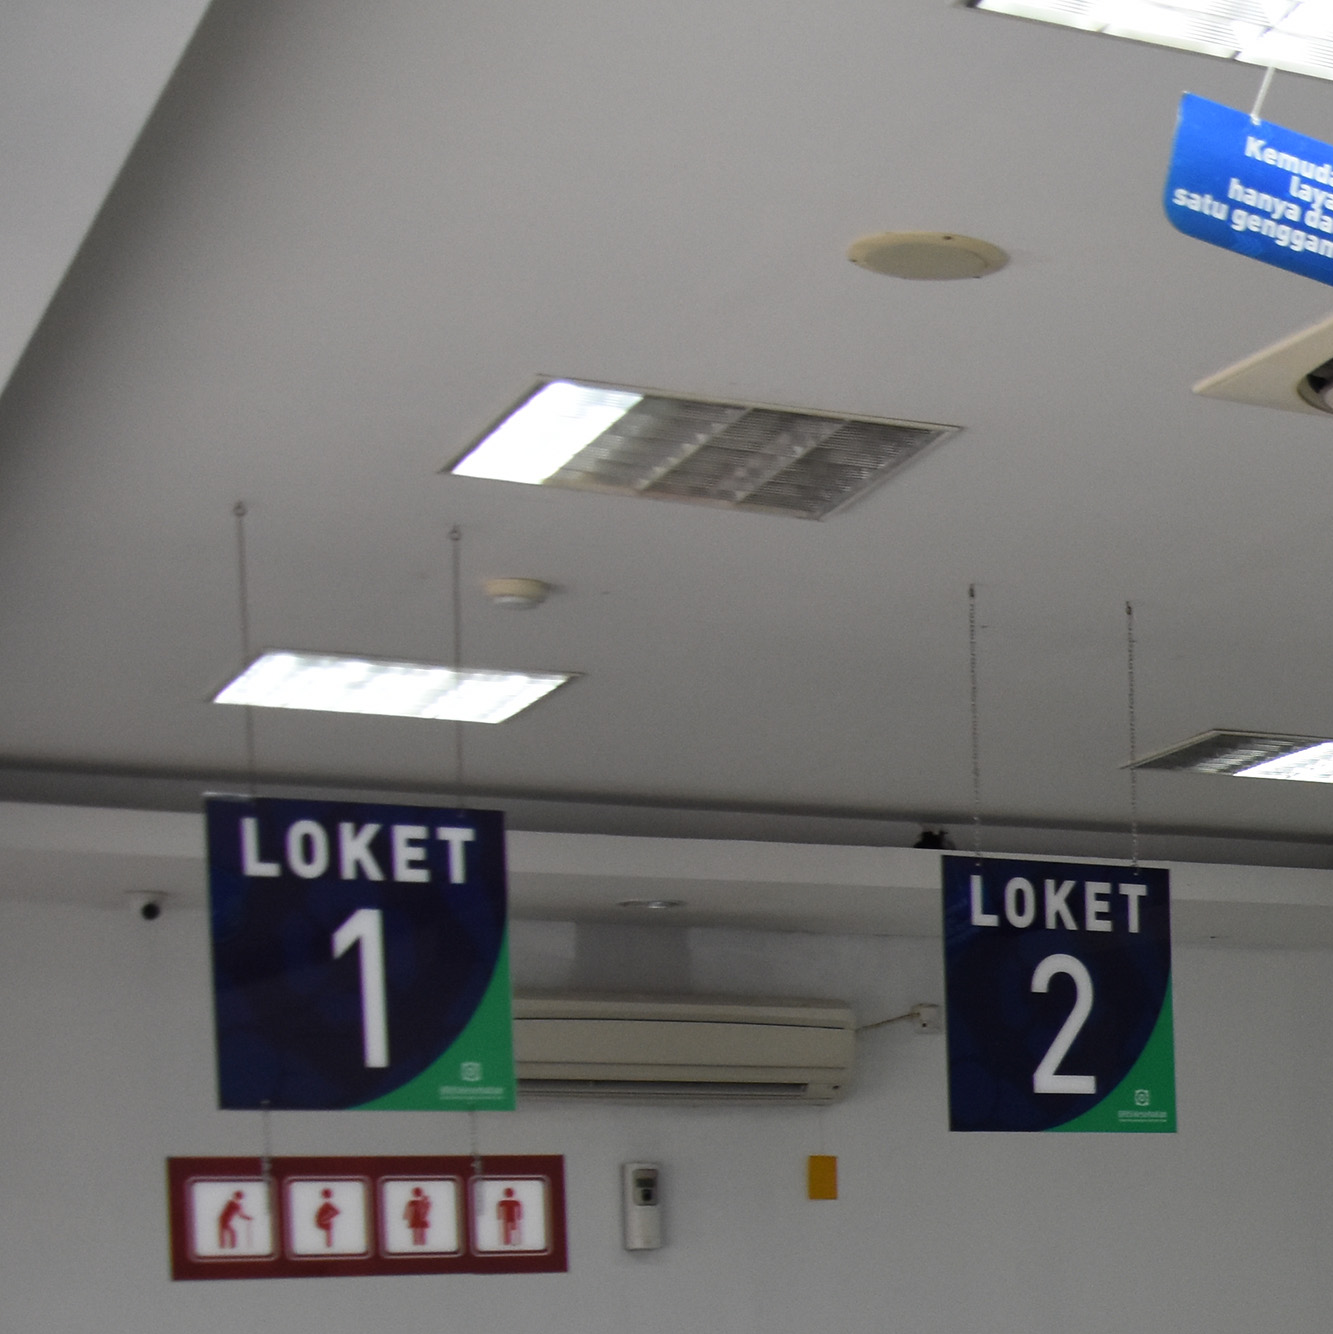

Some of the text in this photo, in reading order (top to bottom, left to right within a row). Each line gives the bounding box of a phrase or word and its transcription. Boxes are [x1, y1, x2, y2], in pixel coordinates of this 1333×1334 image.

[1172, 188, 1230, 221] satu
[1228, 177, 1302, 223] hanya
[240, 817, 476, 885] LOKET
[970, 874, 1148, 934] LOKET
[331, 908, 390, 1069] 1
[1031, 953, 1097, 1094] 2
